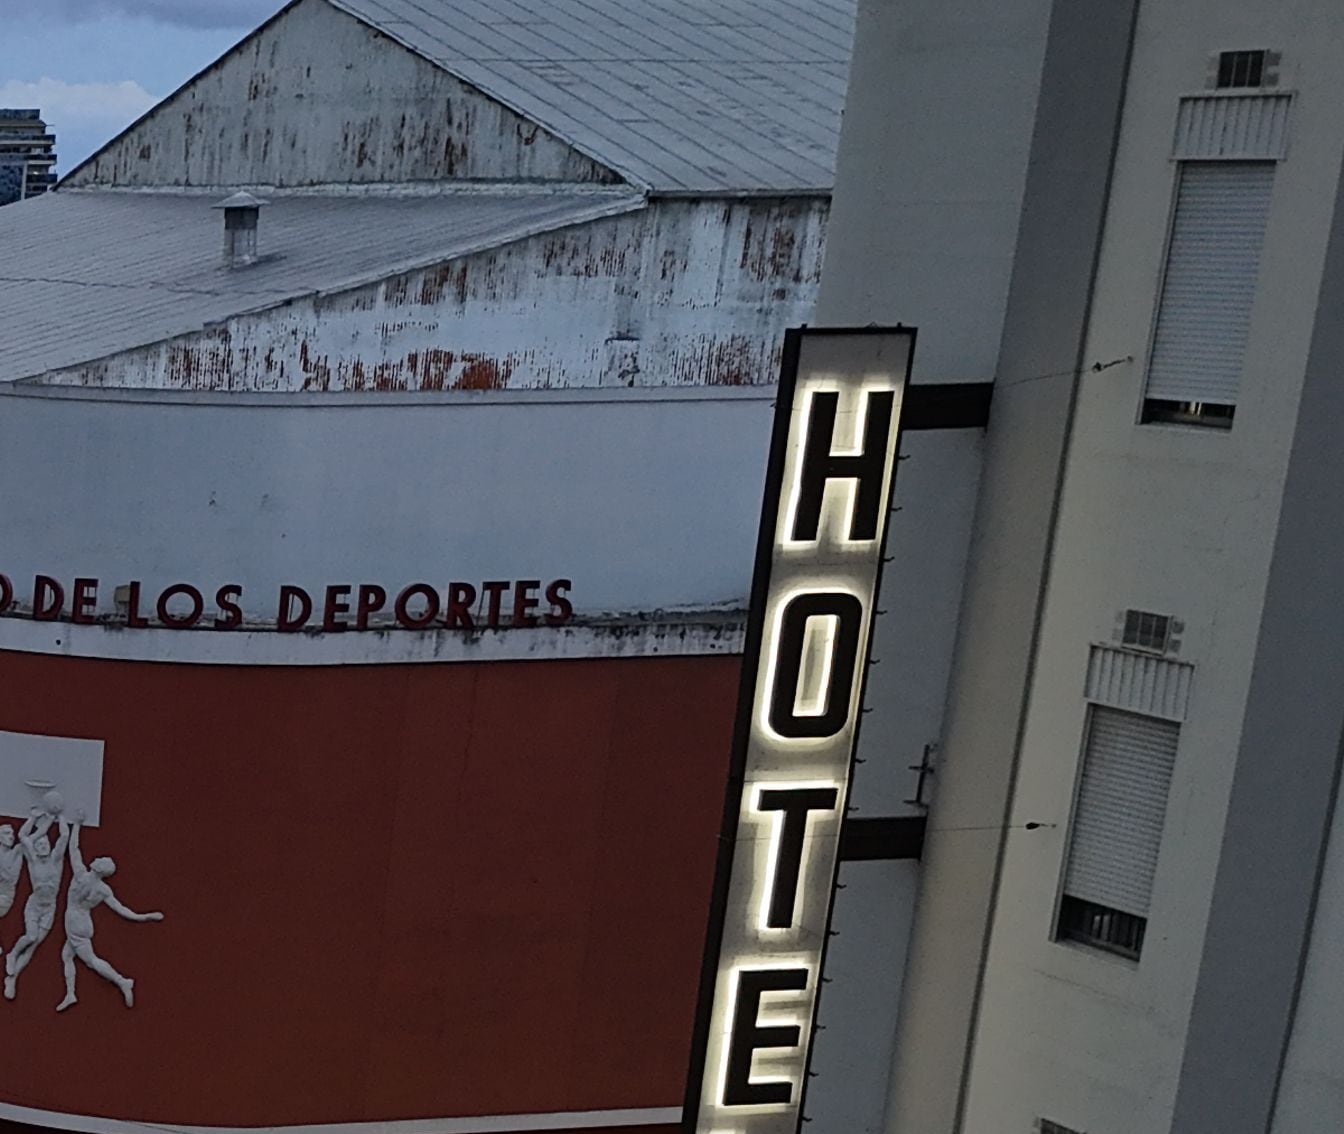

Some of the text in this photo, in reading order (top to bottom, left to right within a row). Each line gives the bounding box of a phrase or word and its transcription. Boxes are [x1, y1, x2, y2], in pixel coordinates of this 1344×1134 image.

[32, 574, 100, 625] DE
[128, 580, 243, 629] LOS
[278, 578, 573, 632] DEPORTES
